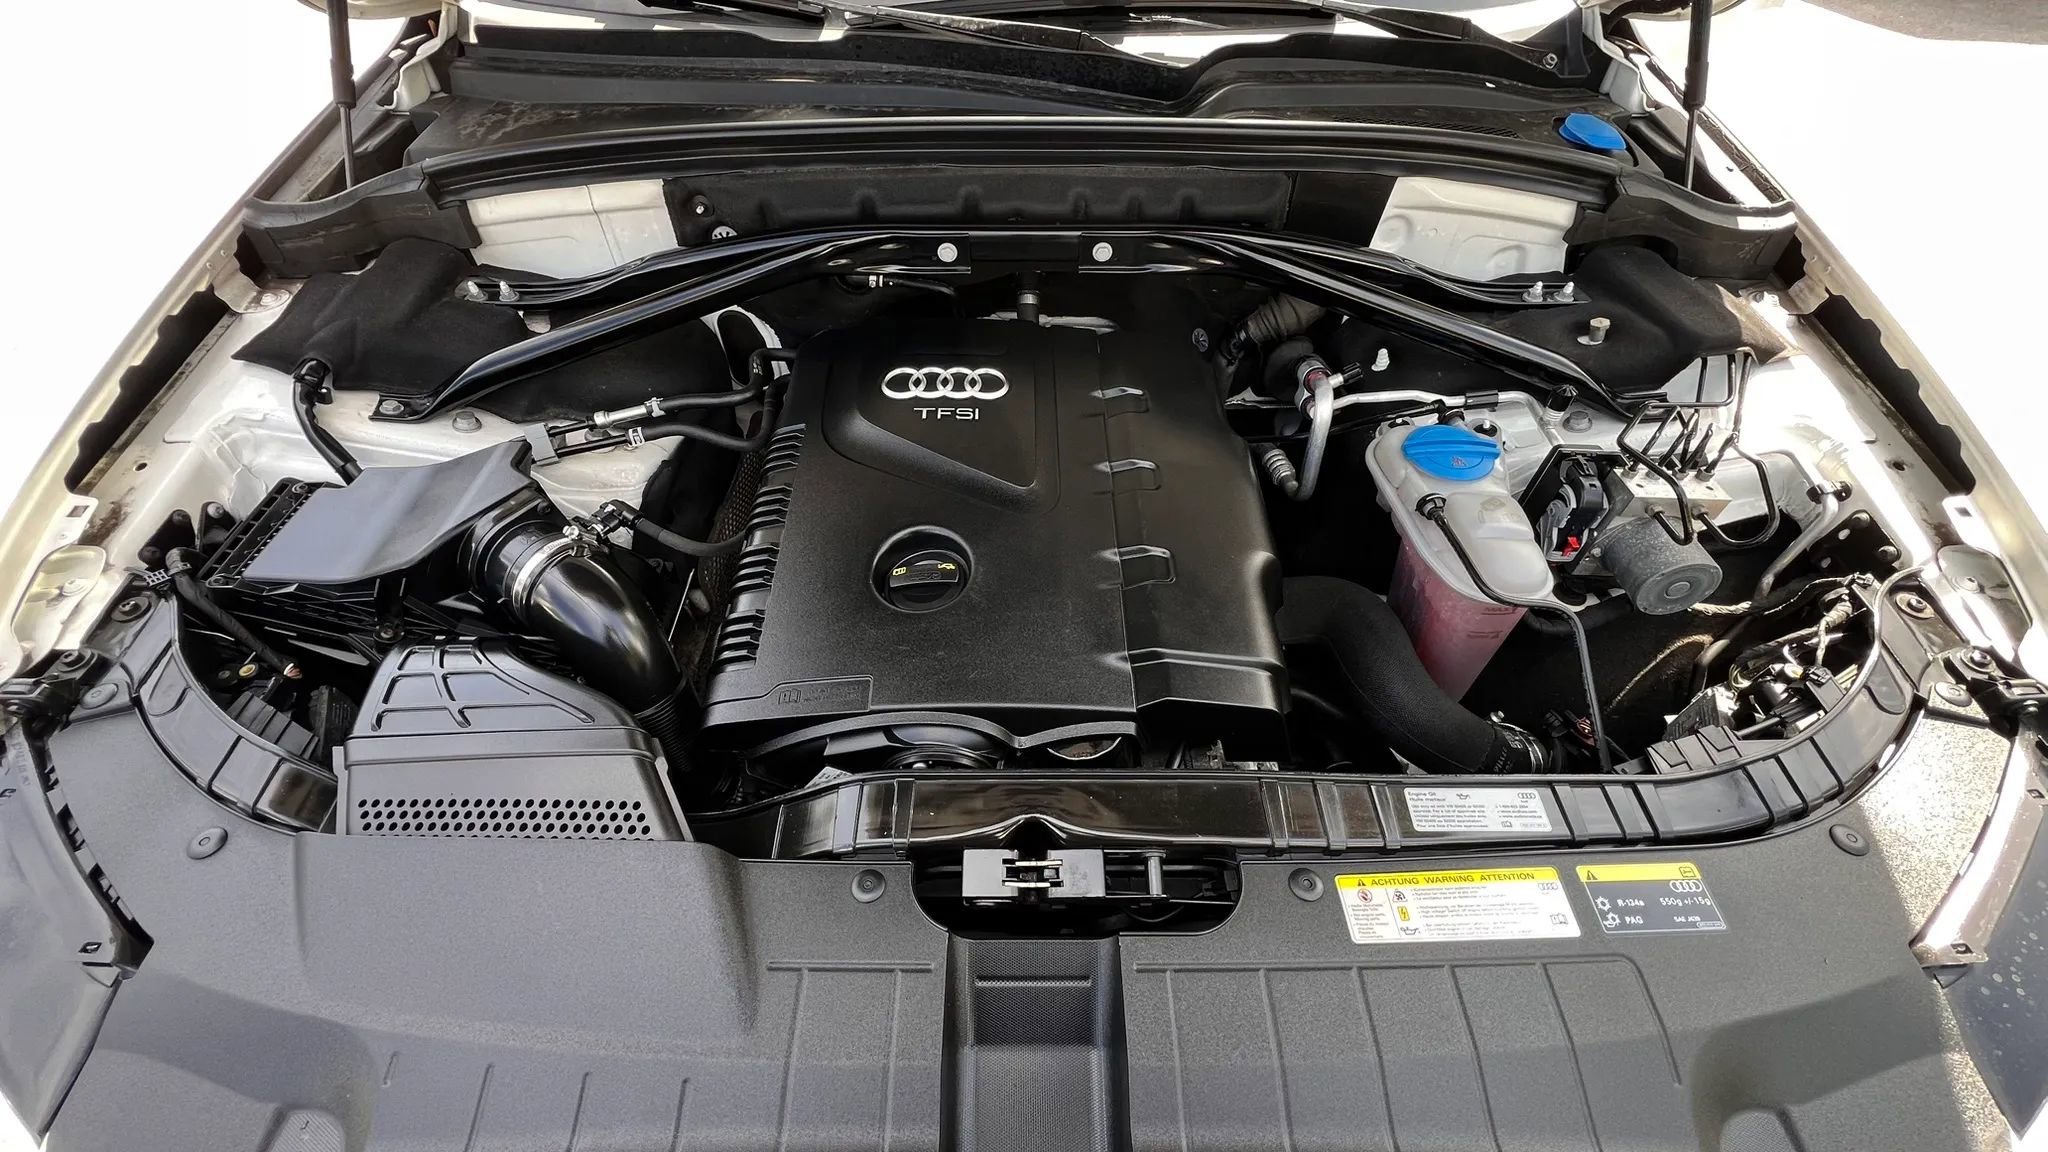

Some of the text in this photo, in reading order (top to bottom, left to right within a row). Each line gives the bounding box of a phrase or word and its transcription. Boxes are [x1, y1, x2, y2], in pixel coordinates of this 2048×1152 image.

[913, 407, 979, 420] TFSI
[1371, 872, 1535, 886] ACHTUNG WARNING ATTENTION
[1660, 897, 1682, 907] 550g
[1625, 916, 1643, 924] PAG
